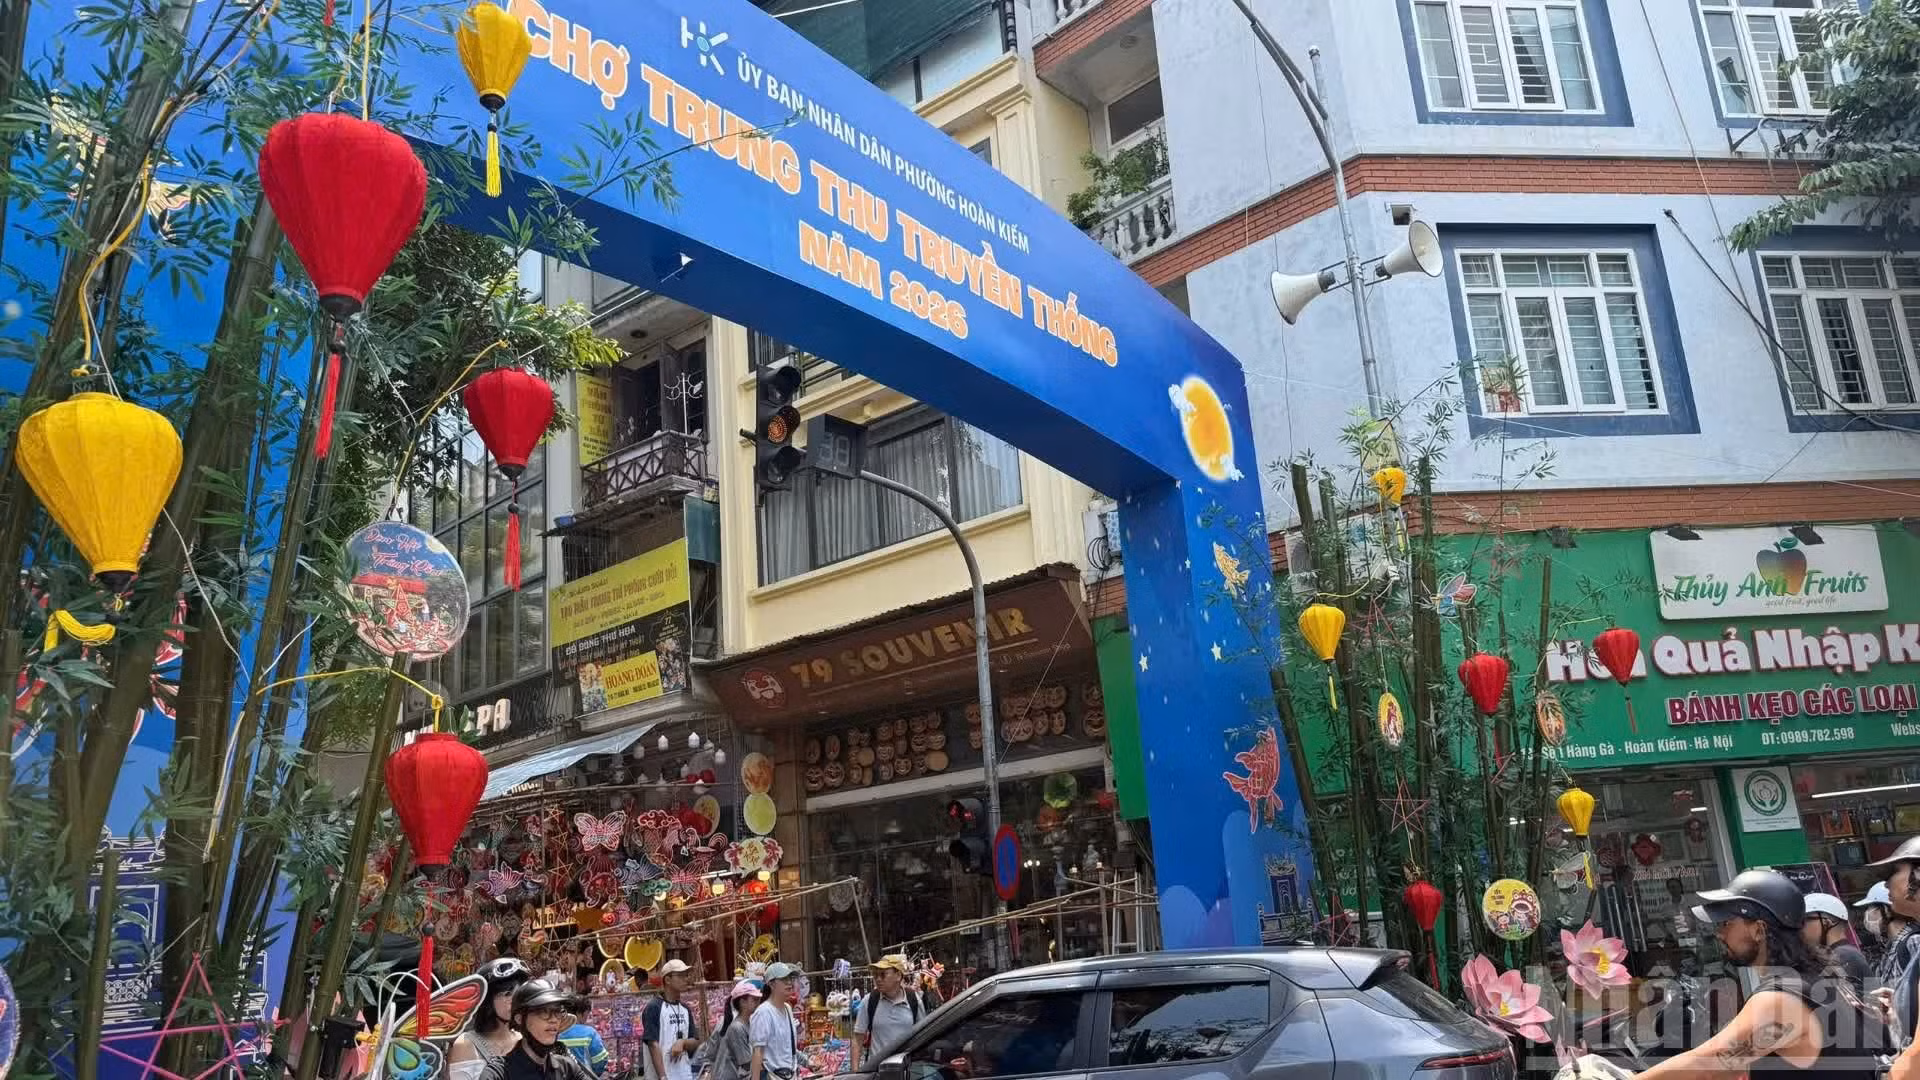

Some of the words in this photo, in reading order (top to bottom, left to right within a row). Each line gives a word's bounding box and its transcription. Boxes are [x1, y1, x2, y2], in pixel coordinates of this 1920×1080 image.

[506, 0, 631, 110] CHỢ
[641, 62, 802, 195] TRUNG
[809, 159, 889, 243] THU
[896, 208, 1024, 319] TRUYỀN
[1027, 284, 1118, 368] THỐNG
[737, 51, 763, 90] ỦY
[767, 74, 804, 112] BAN
[807, 100, 857, 148] NHÂN
[859, 132, 892, 170] DÂN
[895, 157, 956, 209] PHƯỜNG
[958, 197, 996, 234] HOÀN
[998, 217, 1031, 254] KIẾM
[799, 219, 884, 300] NĂM
[890, 270, 969, 339] 2026
[1672, 573, 1728, 606] Thủy
[1736, 571, 1788, 597] Anh
[1804, 569, 1869, 596] Fruits
[789, 657, 834, 689] 79
[840, 607, 1034, 676] SOUVENIR
[1652, 626, 1752, 676] Quả
[1755, 625, 1882, 675] Nhập
[1667, 689, 1742, 726] BÁNH
[1746, 689, 1800, 726] KẸO
[1803, 683, 1855, 716] CÁC
[1857, 683, 1920, 718] LOẠI
[1566, 743, 1597, 758] Hàng
[1599, 741, 1615, 756] Gà
[1624, 738, 1654, 756] Hoàn
[1657, 733, 1687, 752] Kiếm
[1694, 734, 1710, 750] Hà
[1713, 733, 1733, 750] Nội
